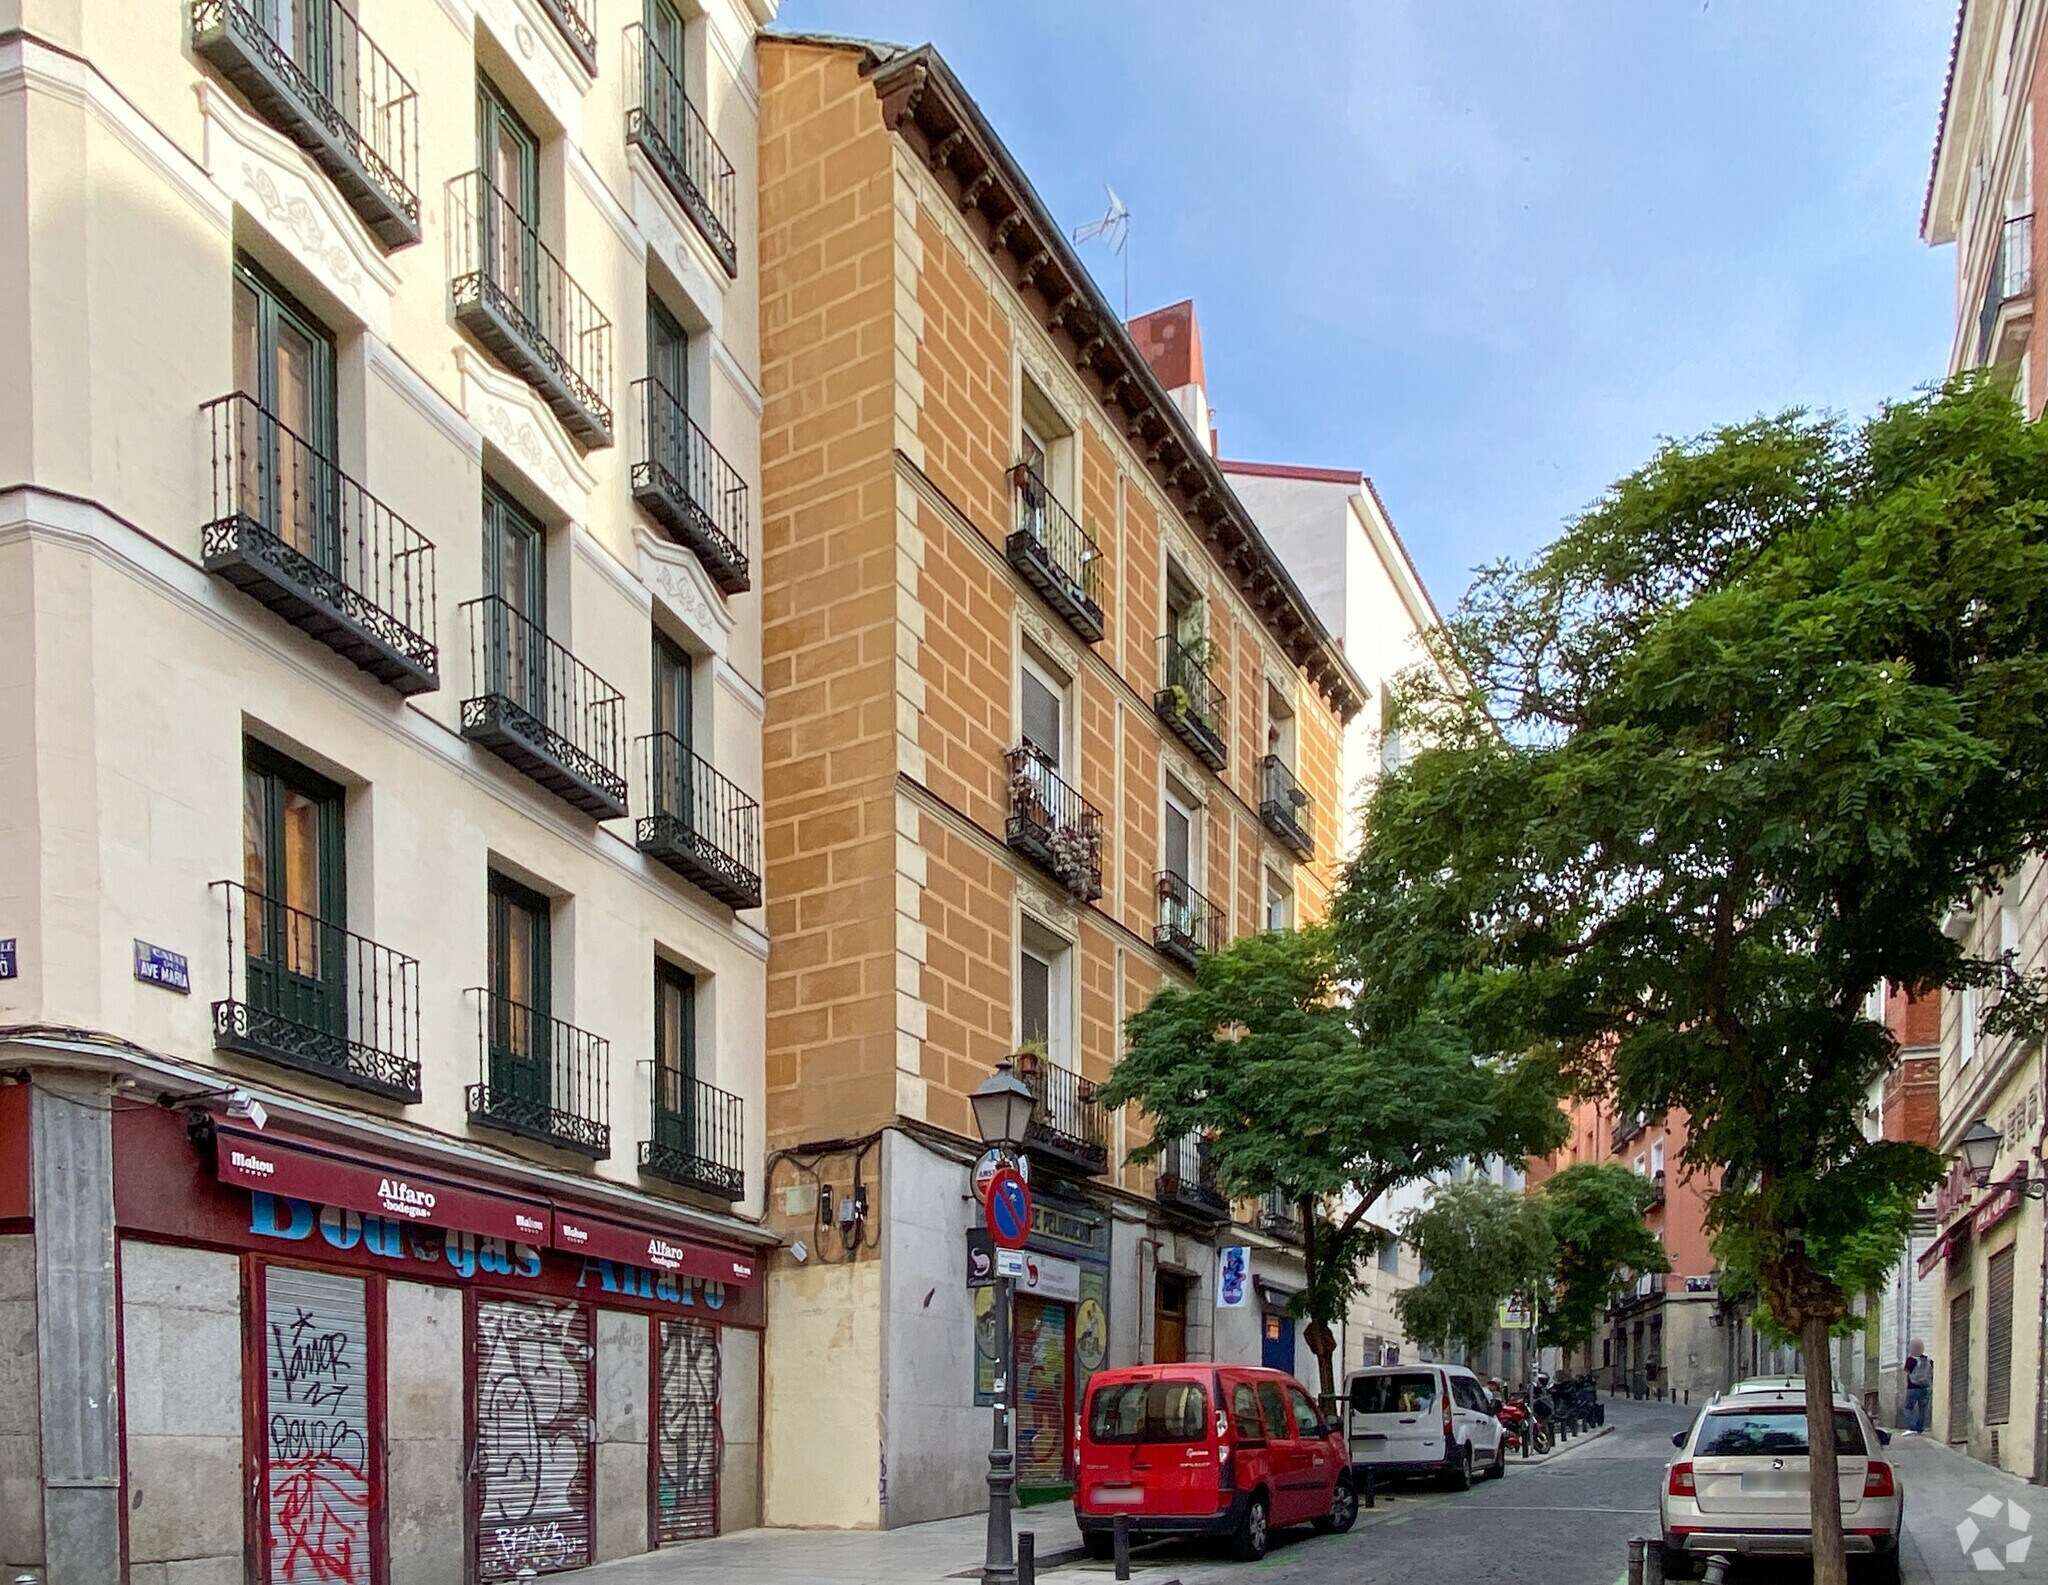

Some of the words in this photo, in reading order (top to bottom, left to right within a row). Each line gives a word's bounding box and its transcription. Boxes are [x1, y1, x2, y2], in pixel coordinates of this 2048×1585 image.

[141, 961, 159, 979] AVE
[231, 1151, 275, 1174] Mahou
[377, 1178, 436, 1208] Alfaro
[648, 1239, 684, 1260] Alfaro
